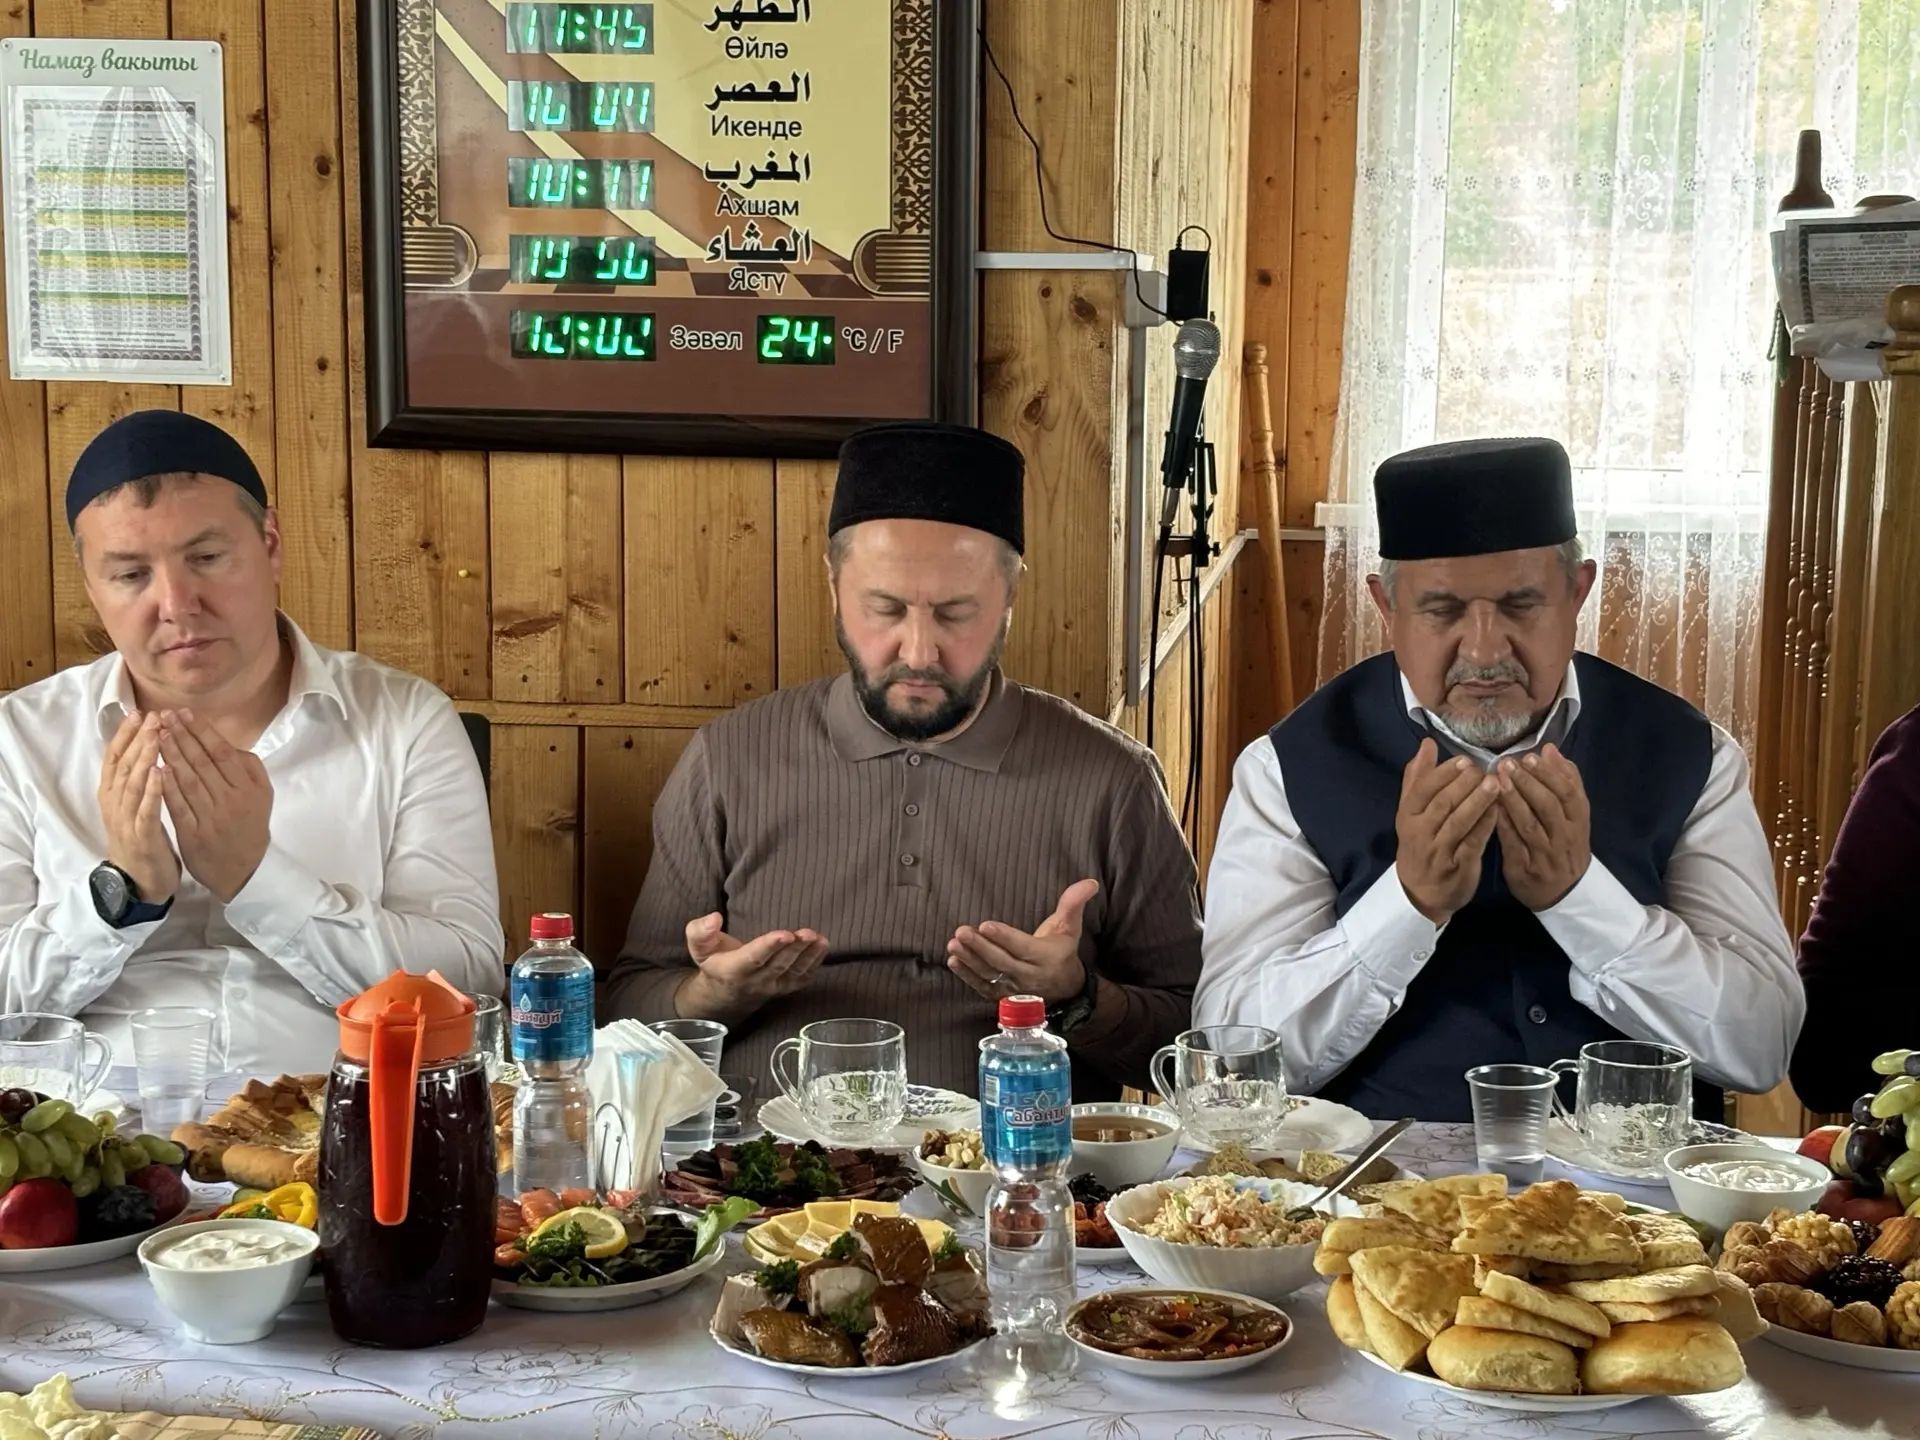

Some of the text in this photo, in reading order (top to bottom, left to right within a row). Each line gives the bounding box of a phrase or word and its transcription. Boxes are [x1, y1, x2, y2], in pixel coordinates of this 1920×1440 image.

[527, 8, 646, 48] 11:45
[19, 47, 199, 79] Намаз вакыты
[725, 36, 788, 59] Өйлә
[703, 71, 811, 111] العصر
[711, 114, 802, 141] Икенде
[704, 150, 811, 190] المغرب
[716, 194, 799, 217] Ахшам
[704, 222, 811, 262] العشاء
[670, 325, 743, 350] Зәвәл
